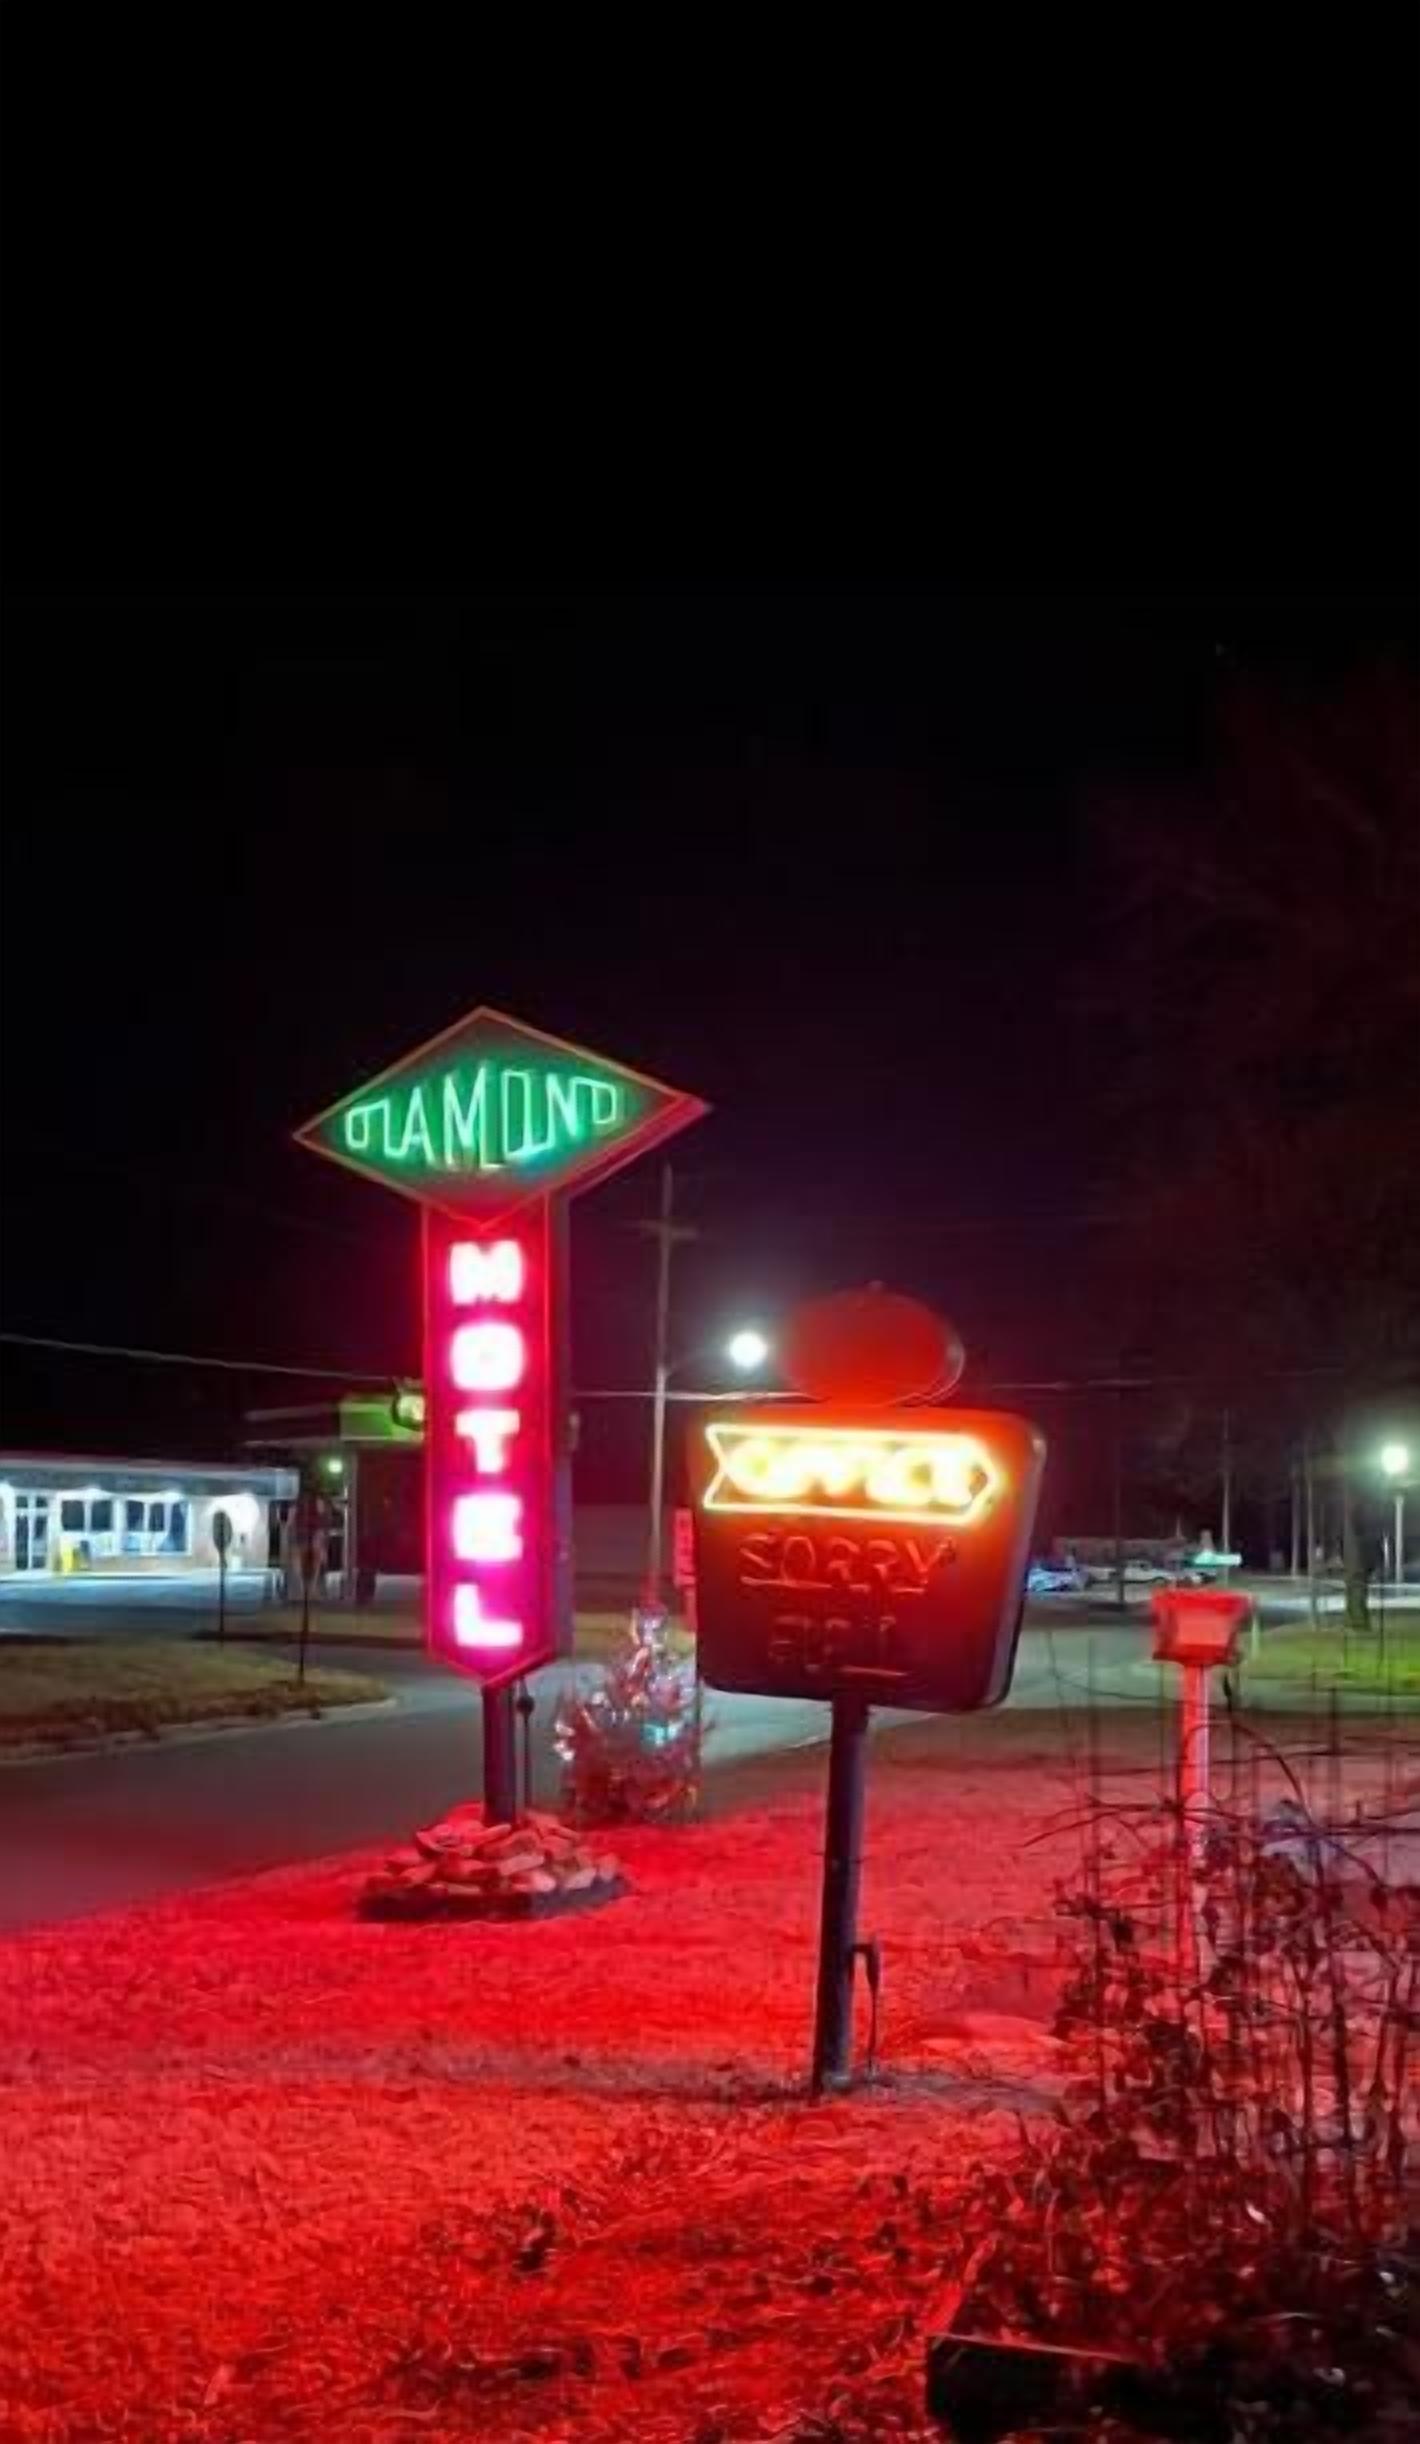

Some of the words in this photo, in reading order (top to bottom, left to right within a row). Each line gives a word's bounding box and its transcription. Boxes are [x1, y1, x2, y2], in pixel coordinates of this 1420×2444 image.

[345, 1066, 617, 1169] DIAMOND
[450, 1240, 524, 1648] MOTEL
[740, 1533, 957, 1595] SORRY
